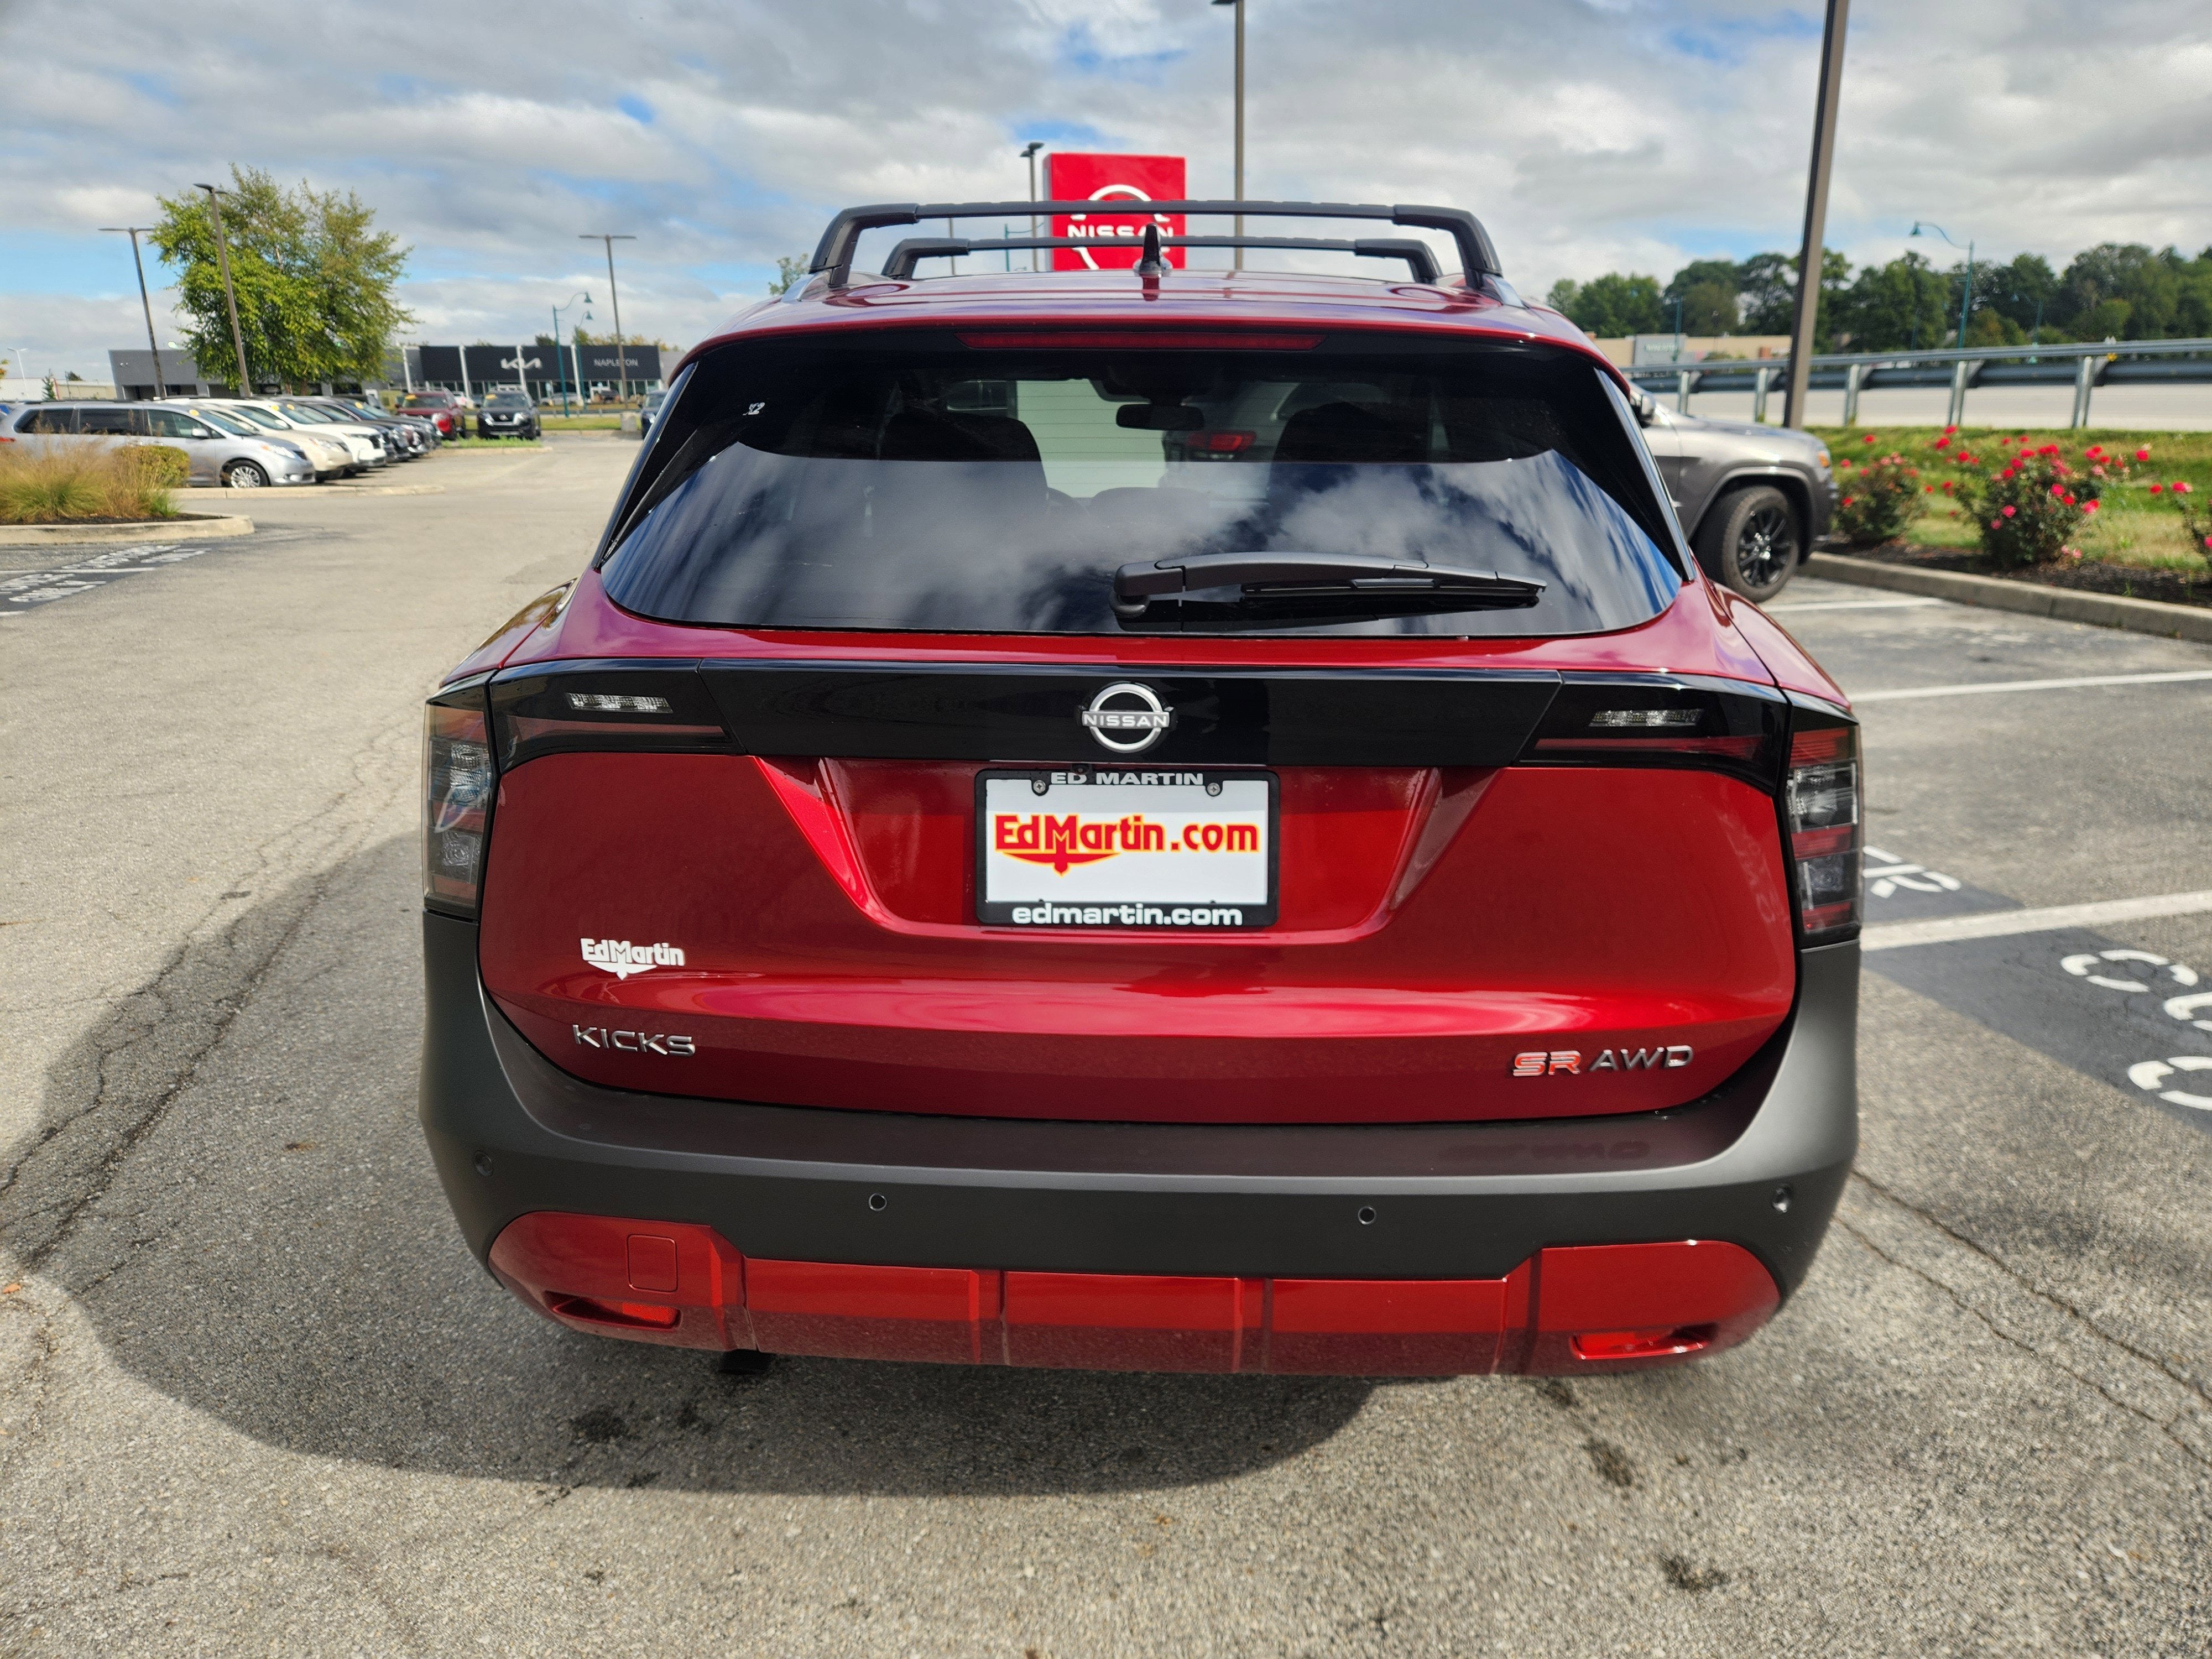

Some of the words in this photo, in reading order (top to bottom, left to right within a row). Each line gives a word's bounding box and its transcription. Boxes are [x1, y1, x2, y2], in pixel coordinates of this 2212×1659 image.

[1067, 224, 1174, 238] NISSN
[500, 357, 542, 369] KA
[594, 358, 638, 366] NAPLEON
[1083, 714, 1167, 727] NISSAN
[1051, 772, 1087, 784] ED
[1096, 773, 1203, 785] MARTIN
[1012, 903, 1243, 925] edmartin.com
[581, 938, 685, 966] EdMartin
[572, 1024, 696, 1057] KICKS
[1512, 1050, 1582, 1077] SR
[1588, 1045, 1694, 1072] AWD
